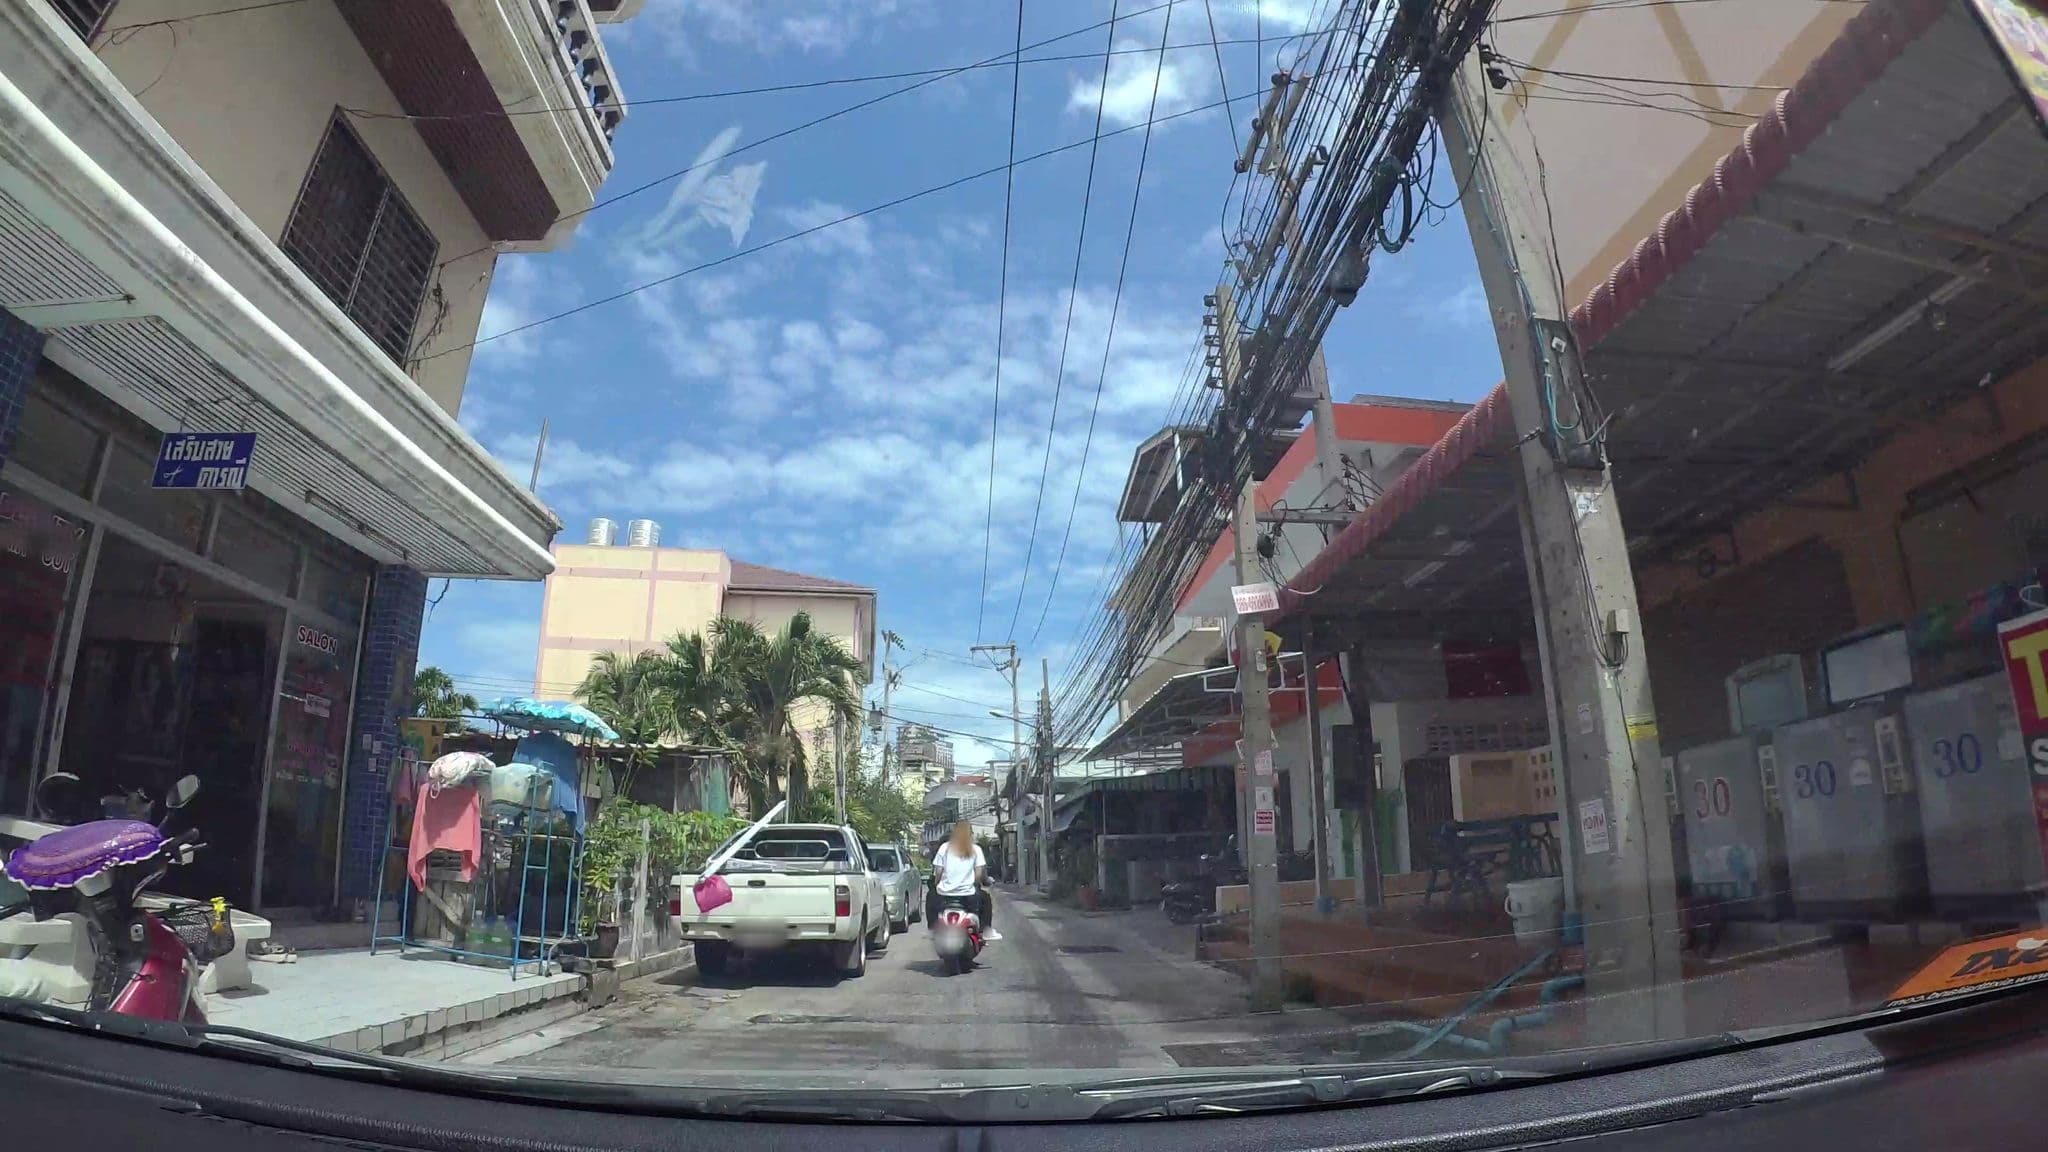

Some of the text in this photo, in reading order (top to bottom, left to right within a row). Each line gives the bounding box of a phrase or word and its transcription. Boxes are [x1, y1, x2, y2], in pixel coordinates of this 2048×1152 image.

[297, 625, 338, 655] SALON
[1933, 733, 1983, 778] 30
[1693, 776, 1731, 819] 30
[1795, 760, 1837, 800] 30
